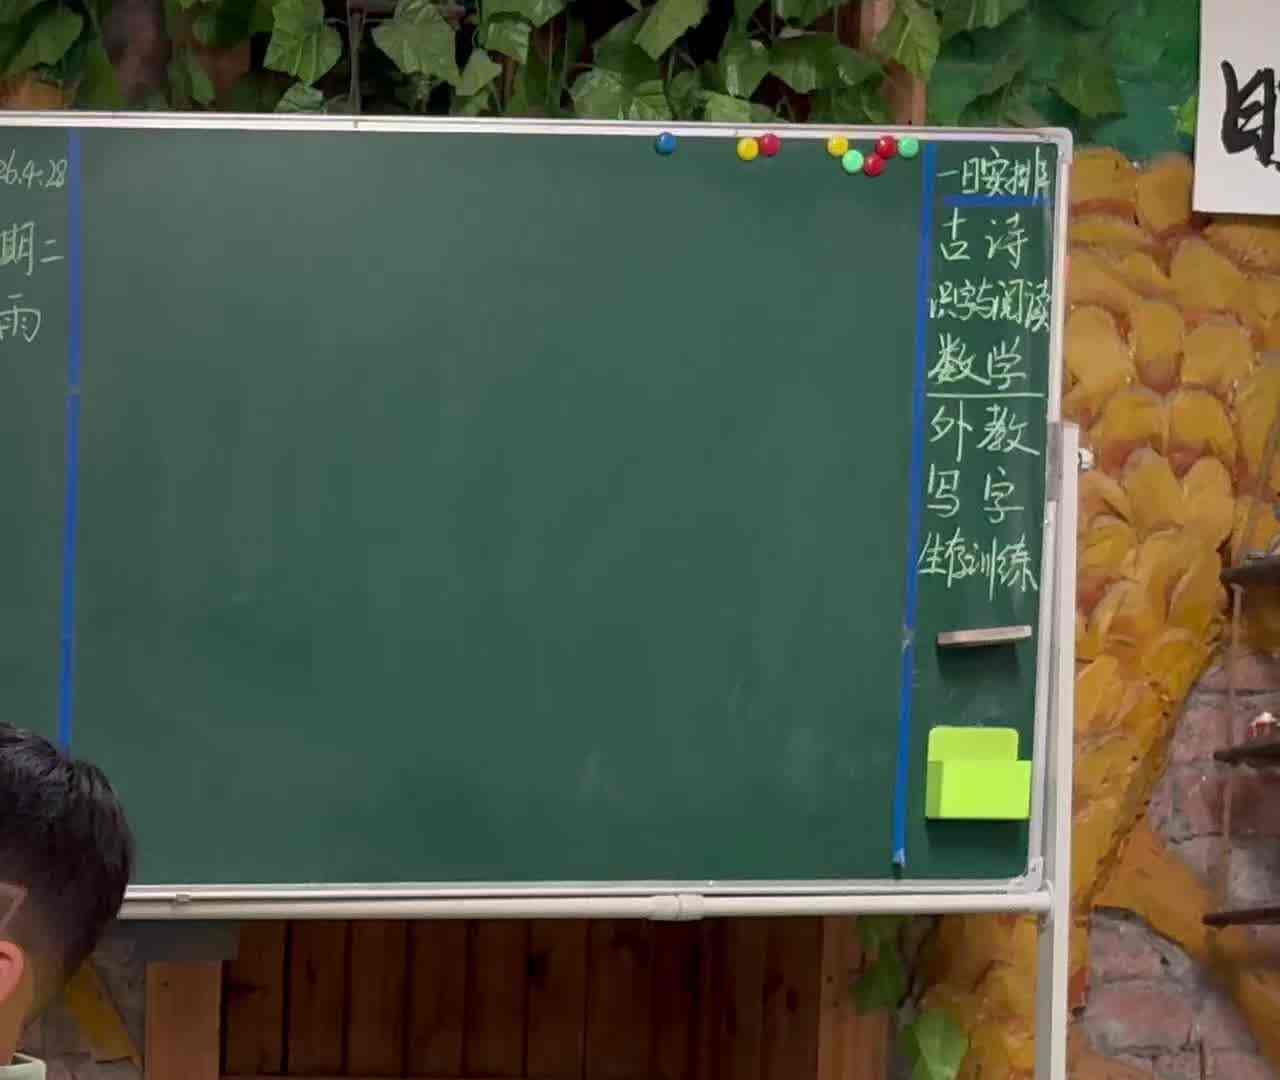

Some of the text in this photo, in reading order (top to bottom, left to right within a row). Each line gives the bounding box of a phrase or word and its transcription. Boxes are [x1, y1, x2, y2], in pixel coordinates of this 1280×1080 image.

[936, 147, 1050, 207] 一日安排
[928, 278, 1050, 330] 识字与阅读
[916, 527, 1039, 602] 生存训练
